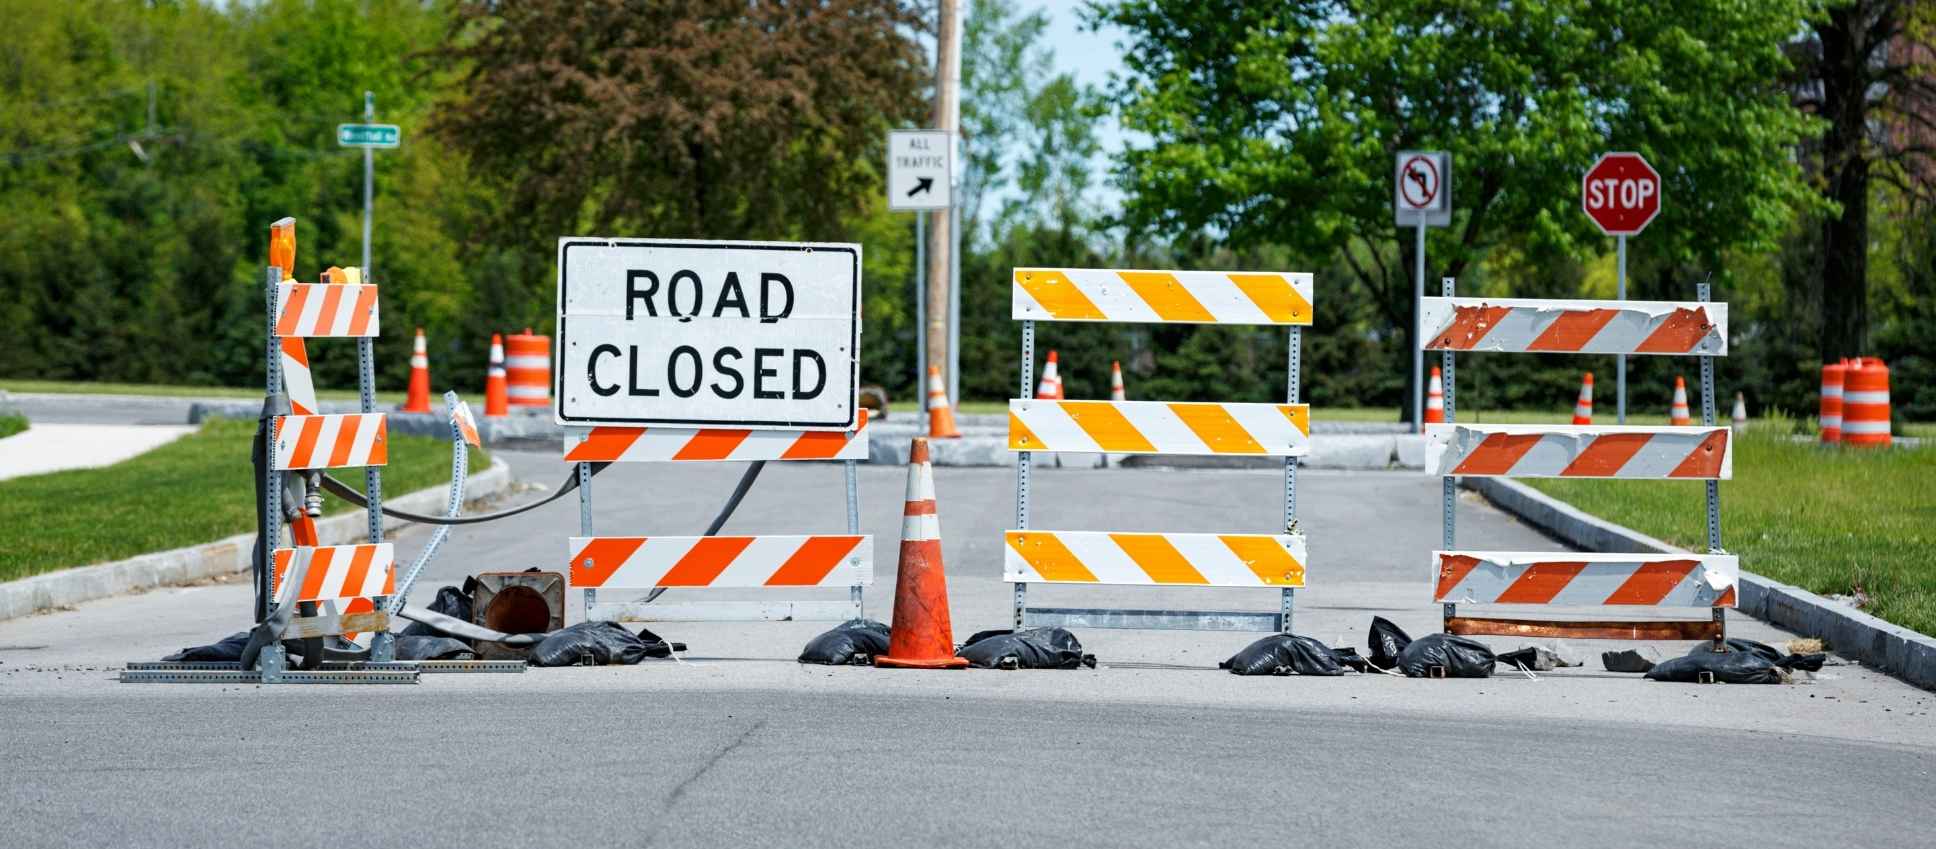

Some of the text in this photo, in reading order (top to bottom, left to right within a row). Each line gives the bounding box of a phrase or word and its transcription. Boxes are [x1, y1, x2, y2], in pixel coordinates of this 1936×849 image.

[909, 138, 930, 150] ALL
[896, 156, 944, 169] TRAFFIC
[1589, 178, 1655, 209] STOP
[625, 269, 795, 324] ROAD
[587, 343, 827, 400] CLOSED
